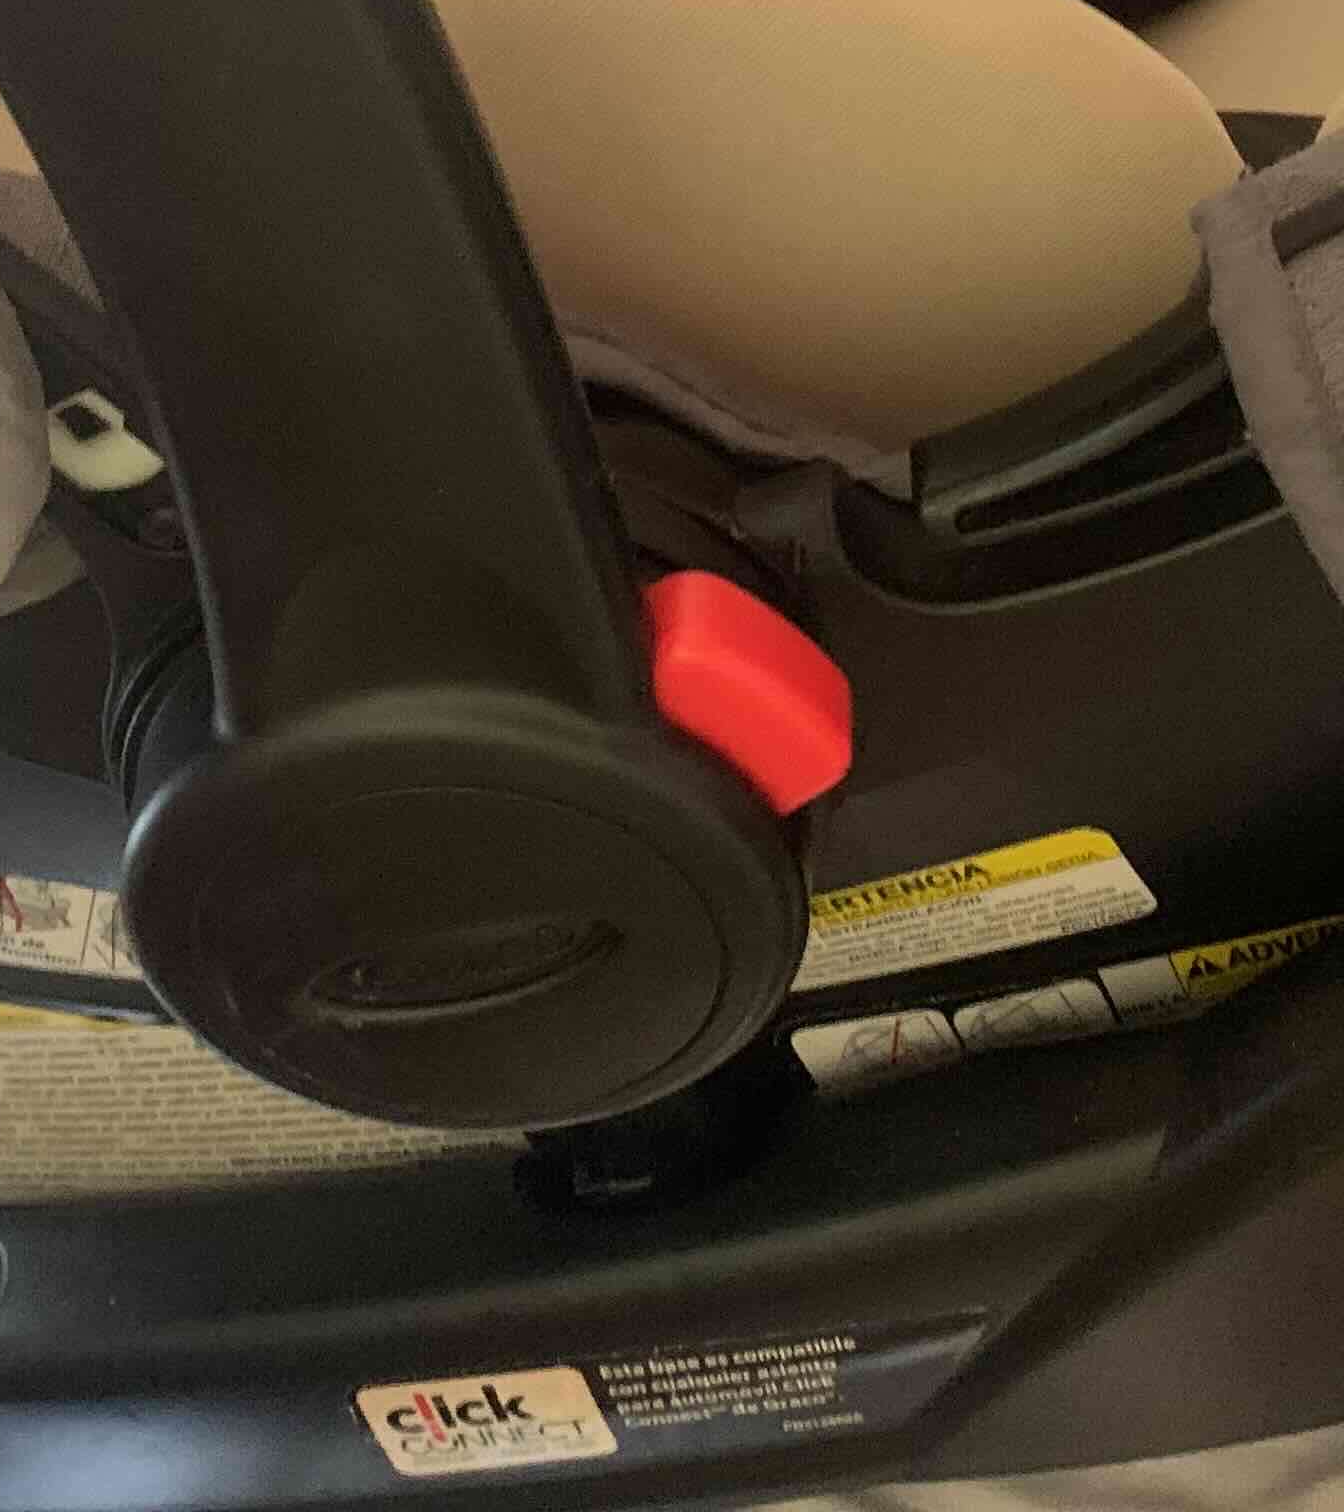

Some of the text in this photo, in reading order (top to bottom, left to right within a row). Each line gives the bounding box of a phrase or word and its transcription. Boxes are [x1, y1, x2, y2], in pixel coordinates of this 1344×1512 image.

[598, 1363, 646, 1381] Esta
[732, 1335, 857, 1364] compatible
[386, 1383, 535, 1443] click
